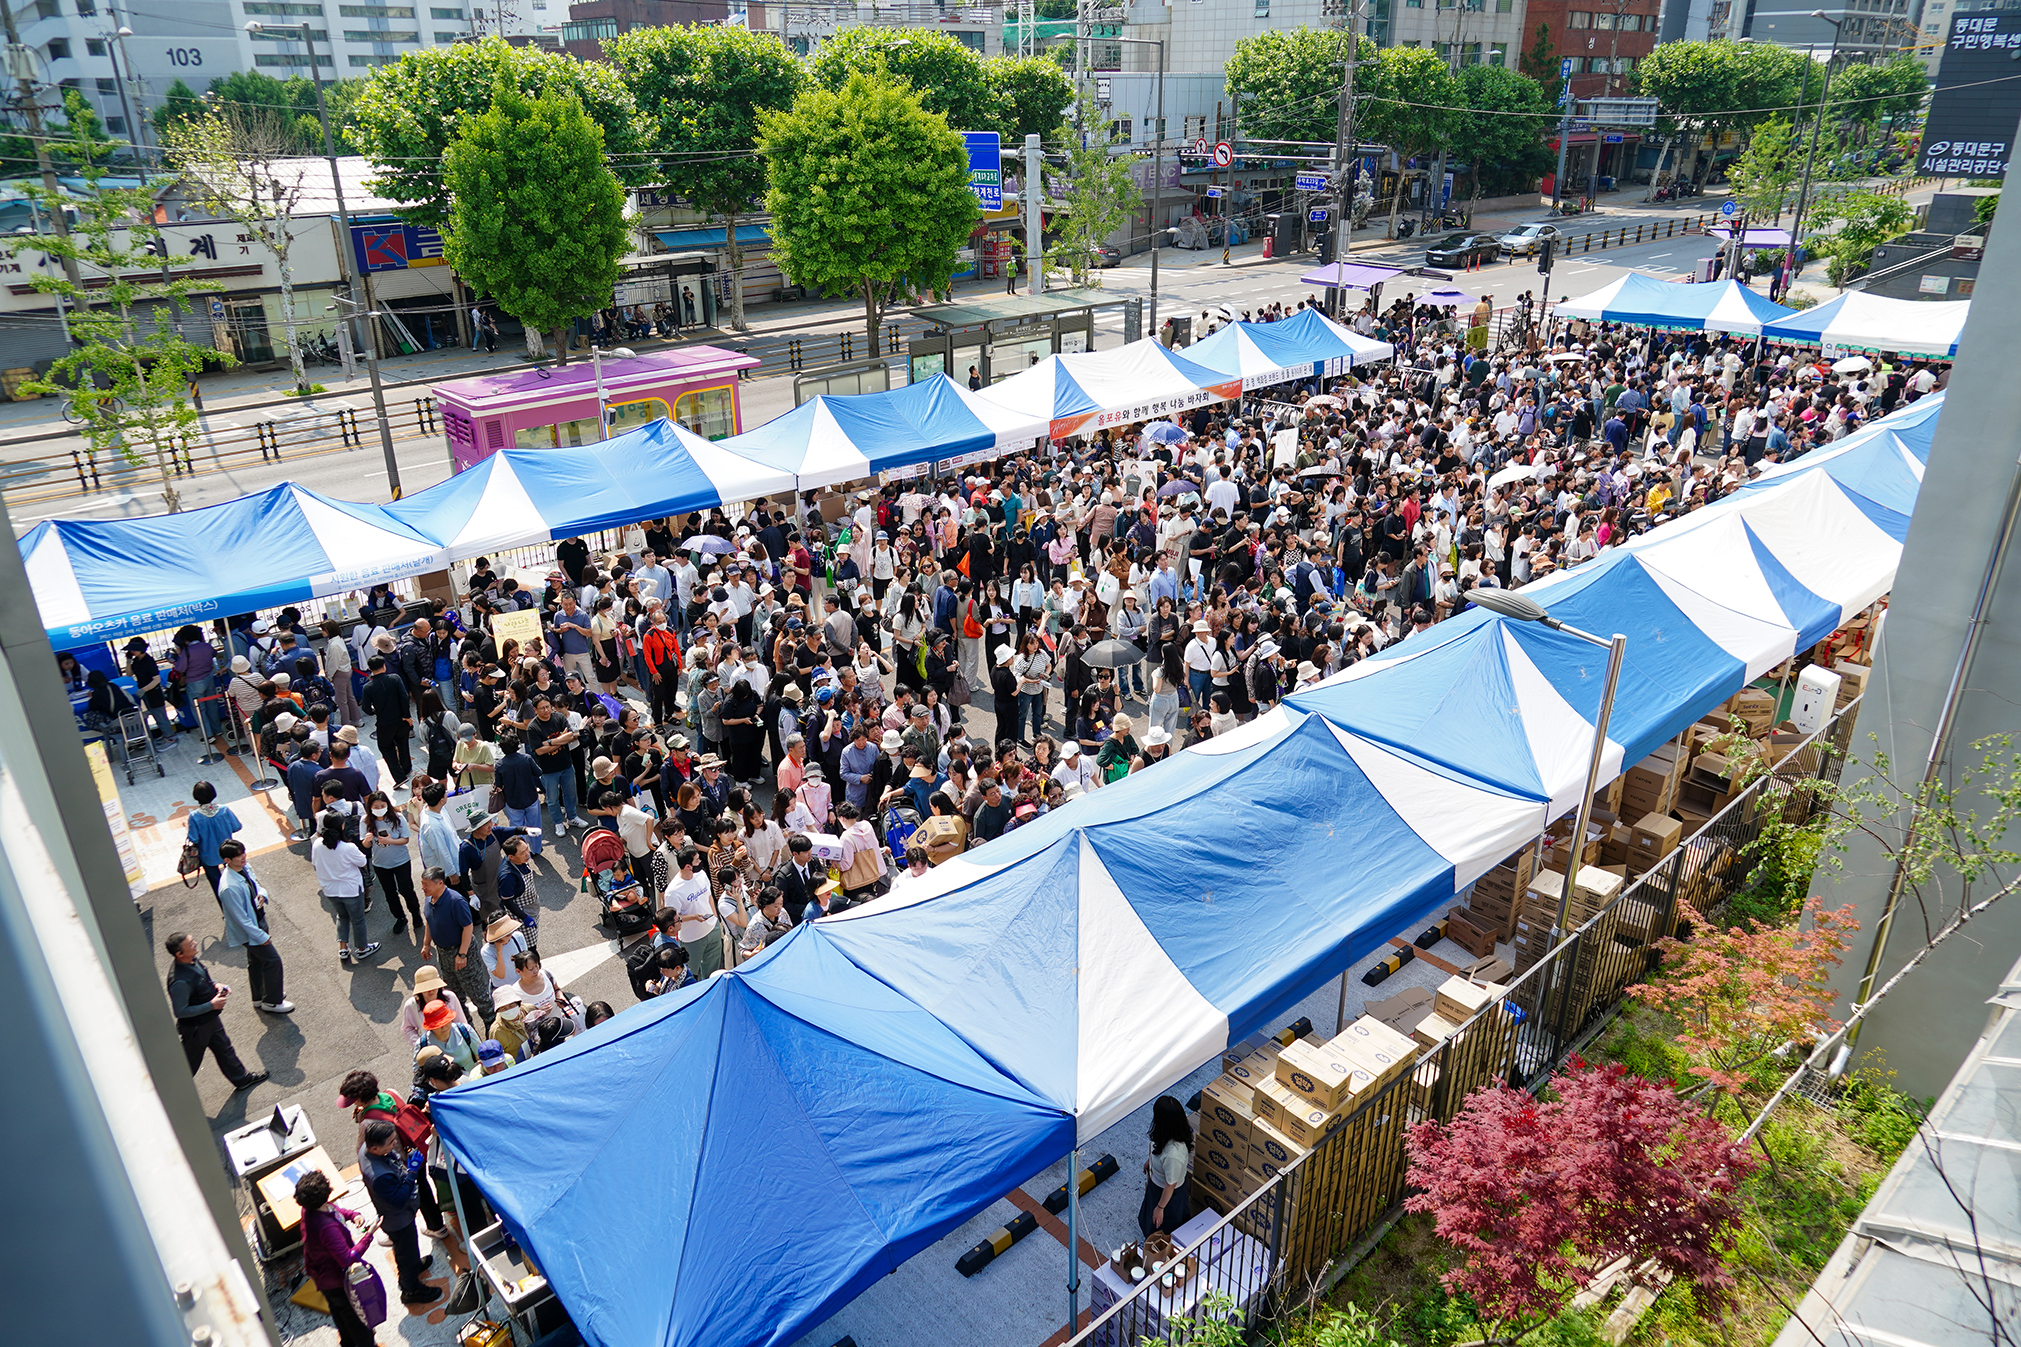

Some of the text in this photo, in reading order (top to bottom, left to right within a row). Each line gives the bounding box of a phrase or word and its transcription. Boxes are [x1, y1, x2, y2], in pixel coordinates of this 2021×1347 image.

[1955, 17, 1999, 34] 동대문
[166, 47, 203, 66] 103
[1951, 141, 2006, 157] 동대문구
[1921, 157, 2002, 175] 시설관리공단
[1097, 408, 1131, 427] 올포유와
[1133, 404, 1149, 419] 함께
[1152, 401, 1167, 415] 행복
[1169, 397, 1185, 410] 나눔
[1187, 390, 1210, 406] 바자회
[330, 570, 359, 584] 시원한
[361, 566, 380, 579] 음료
[69, 599, 219, 638] 동아오츠카 음료 판매처(박스)
[455, 801, 480, 814] OREGON
